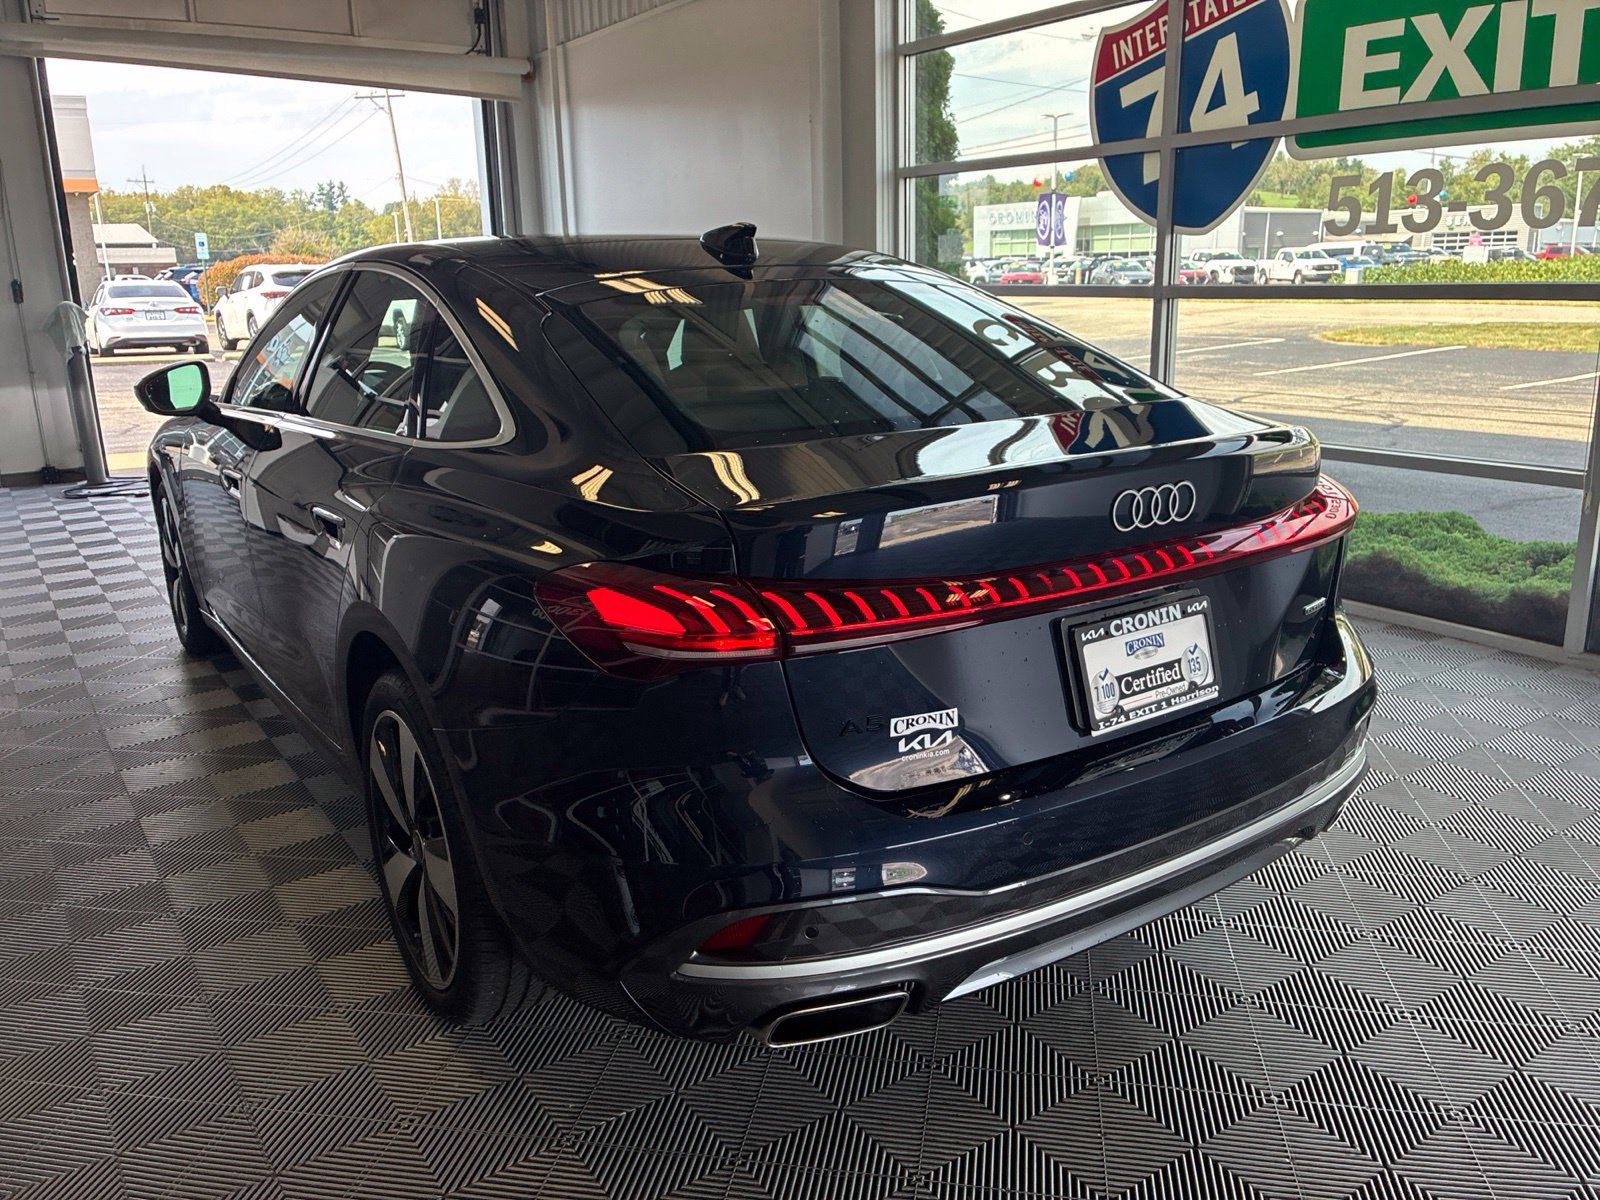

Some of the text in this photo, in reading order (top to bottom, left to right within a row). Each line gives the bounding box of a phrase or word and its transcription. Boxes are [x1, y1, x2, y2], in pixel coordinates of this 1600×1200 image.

[1112, 0, 1242, 69] INTERTAT
[1338, 0, 1600, 111] EXIT
[1119, 32, 1260, 185] 74
[1109, 603, 1182, 637] CRONIN
[1126, 633, 1164, 655] CRONIN
[1187, 656, 1202, 674] 135
[1120, 662, 1181, 695] Certified
[1154, 683, 1186, 699] Pre-Owned
[1094, 682, 1116, 702] 7 100
[1098, 716, 1127, 730] I-74
[1129, 705, 1158, 719] EXIT
[1161, 701, 1169, 709] 1
[1171, 684, 1219, 706] Harrison
[893, 710, 956, 735] CRONIN
[898, 730, 953, 752] KIA
[901, 748, 950, 762] croninkia.com
